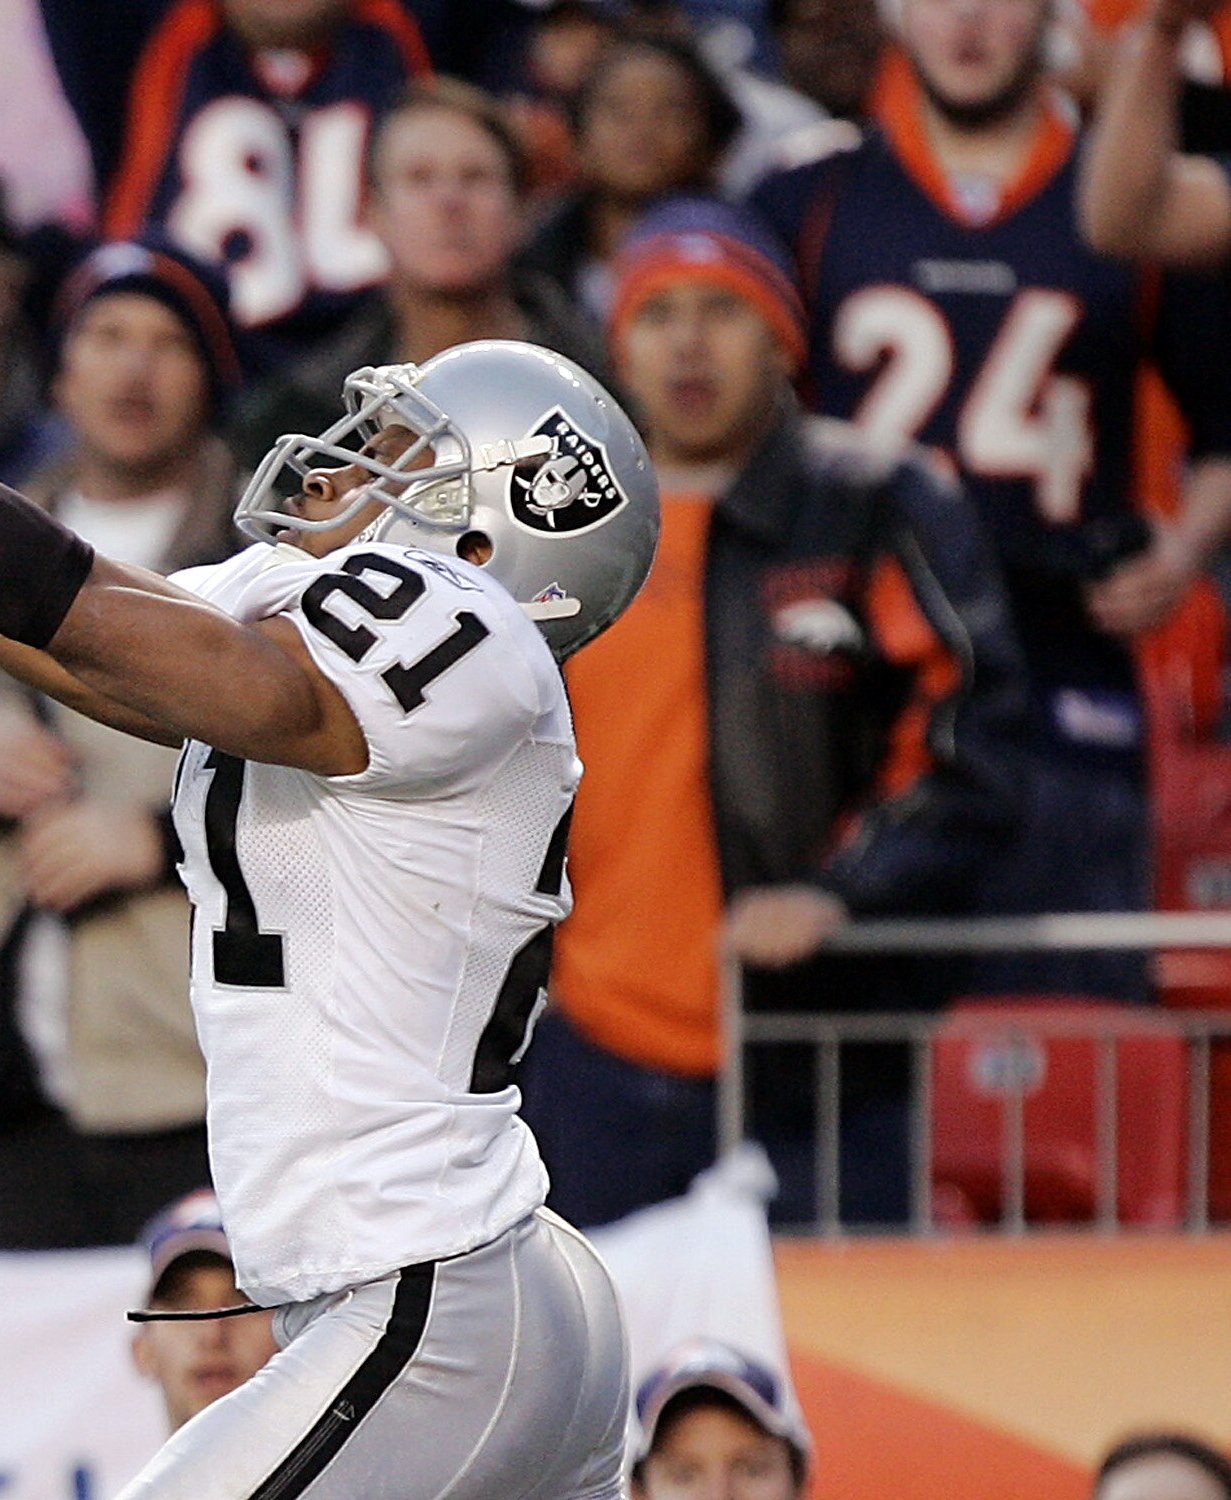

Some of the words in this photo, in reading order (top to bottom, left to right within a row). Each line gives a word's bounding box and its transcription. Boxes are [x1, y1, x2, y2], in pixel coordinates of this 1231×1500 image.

[556, 421, 617, 500] RAIDERS
[812, 280, 1096, 525] 24
[300, 551, 492, 714] 21
[171, 740, 288, 989] 1
